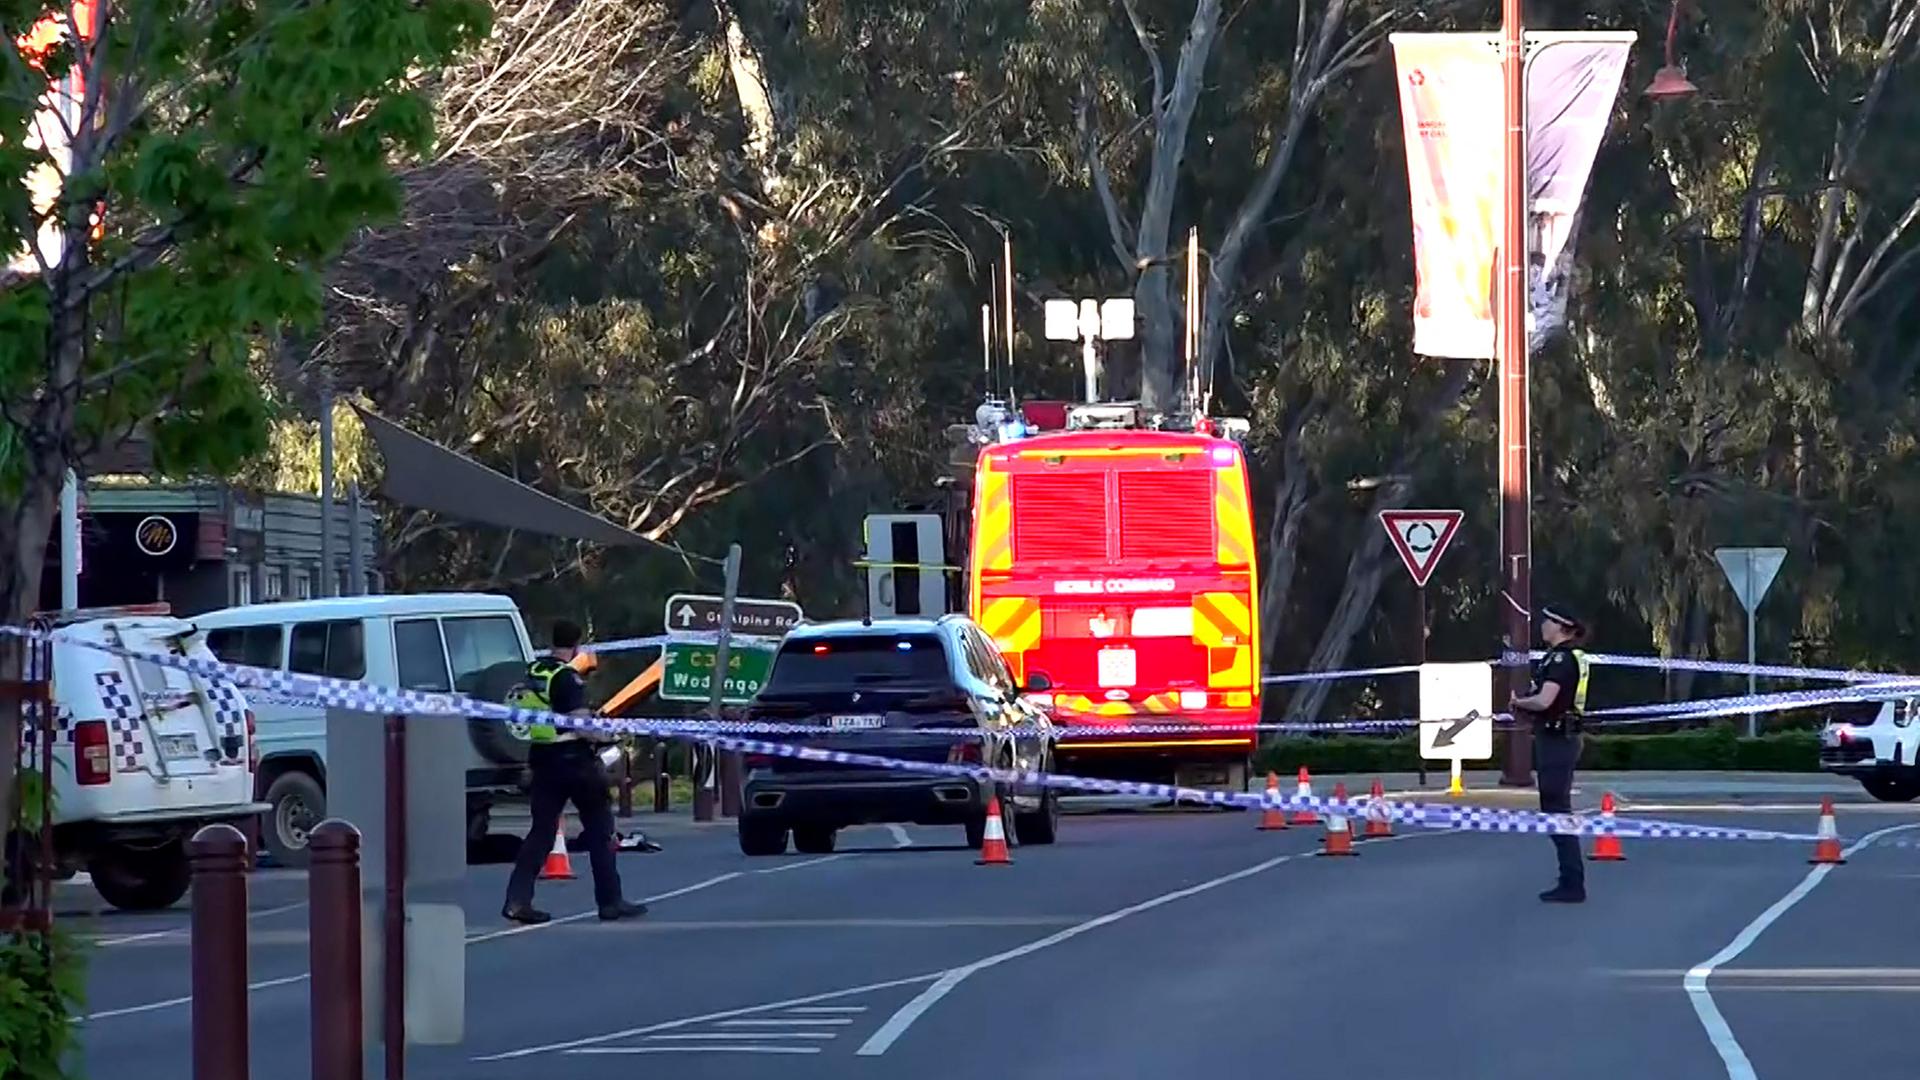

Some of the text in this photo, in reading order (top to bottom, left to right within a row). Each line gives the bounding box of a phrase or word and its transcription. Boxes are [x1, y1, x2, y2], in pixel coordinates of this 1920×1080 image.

[1105, 578, 1176, 593] COMMAND
[690, 651, 741, 668] C34
[673, 672, 758, 695] Wodnga
